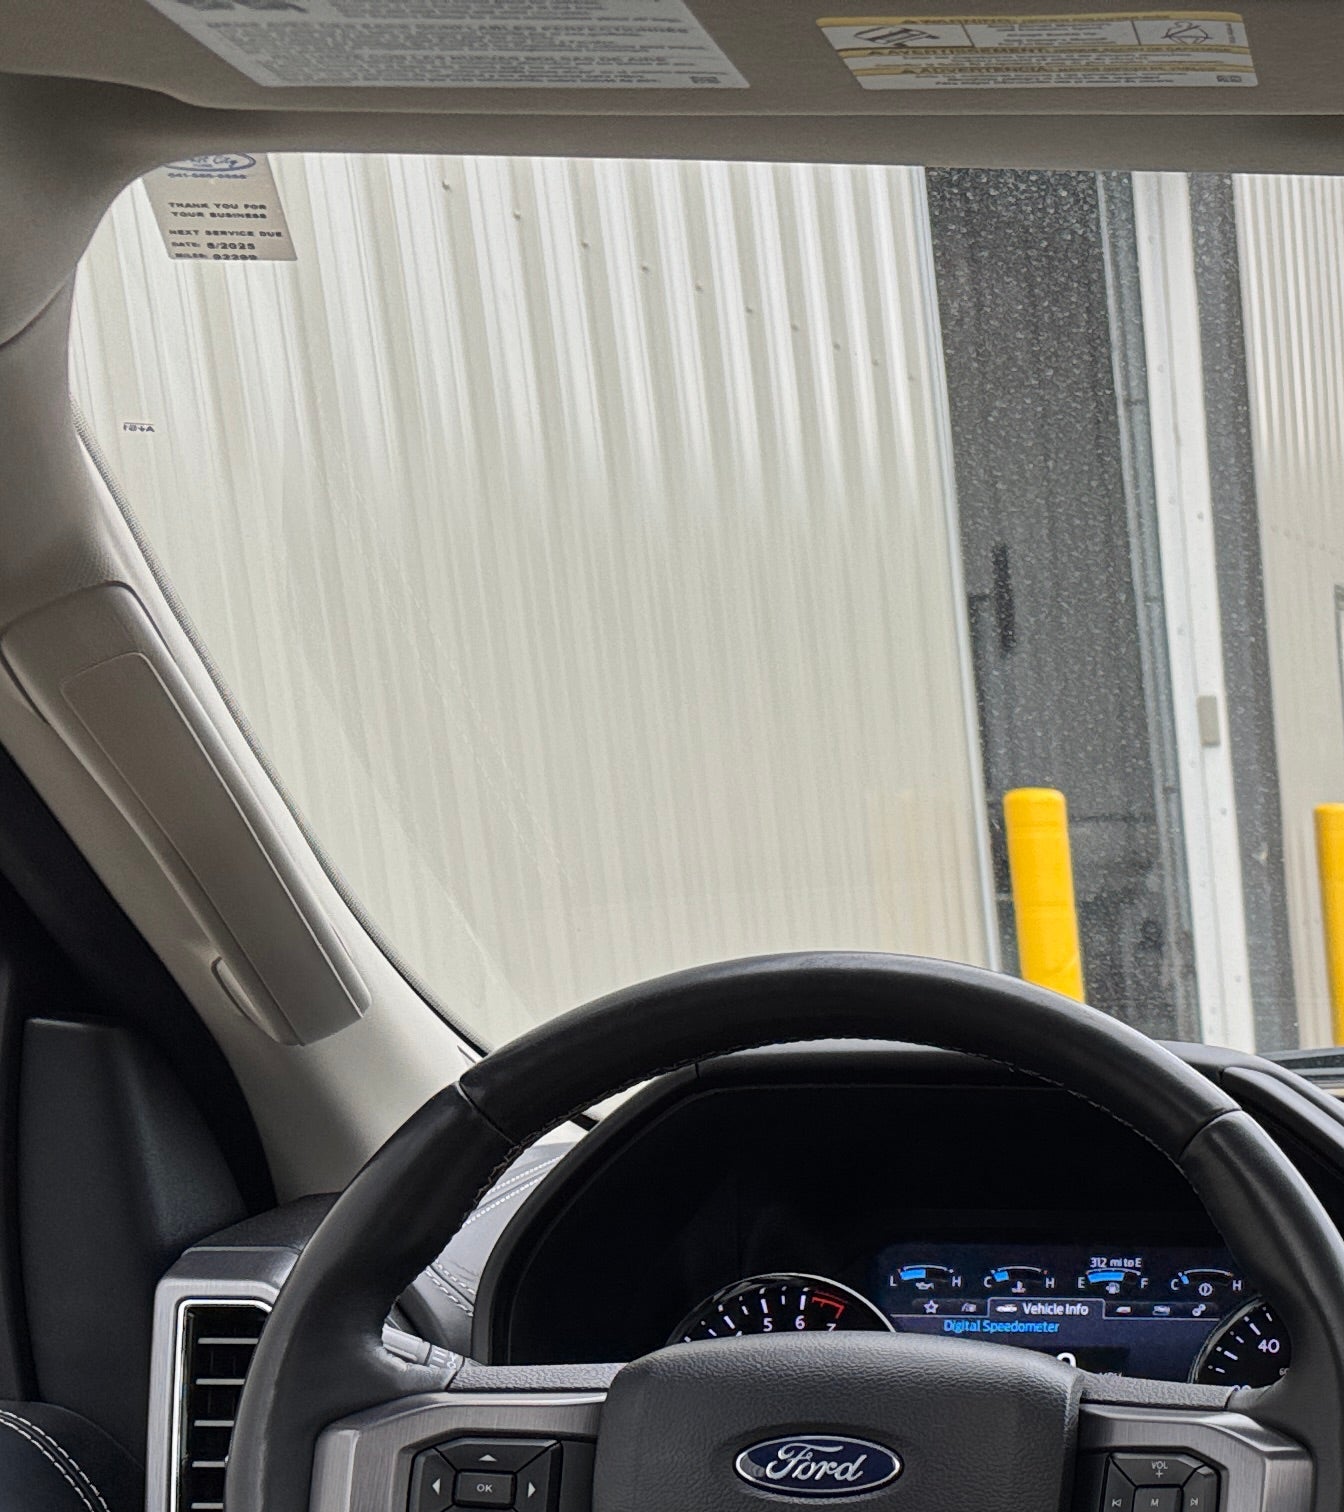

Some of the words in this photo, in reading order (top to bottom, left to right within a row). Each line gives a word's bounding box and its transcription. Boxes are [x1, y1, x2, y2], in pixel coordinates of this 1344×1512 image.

[1090, 1257, 1107, 1267] 312
[889, 1276, 897, 1287] L
[952, 1277, 961, 1287] H
[984, 1276, 992, 1288] C
[1046, 1277, 1055, 1288] H
[1078, 1277, 1085, 1289] E
[1141, 1278, 1148, 1289] F
[1171, 1279, 1179, 1290] C
[1233, 1280, 1242, 1291] H
[1022, 1303, 1063, 1315] Vehicle
[1065, 1303, 1089, 1315] Info
[763, 1318, 773, 1331] 5
[795, 1315, 805, 1329] 6
[944, 1320, 980, 1333] Digital
[982, 1320, 1059, 1333] Speedometer
[1258, 1338, 1280, 1353] 40
[765, 1442, 868, 1481] Ford
[1151, 1461, 1168, 1470] VOL
[476, 1483, 493, 1493] OK
[1151, 1499, 1159, 1507] M
